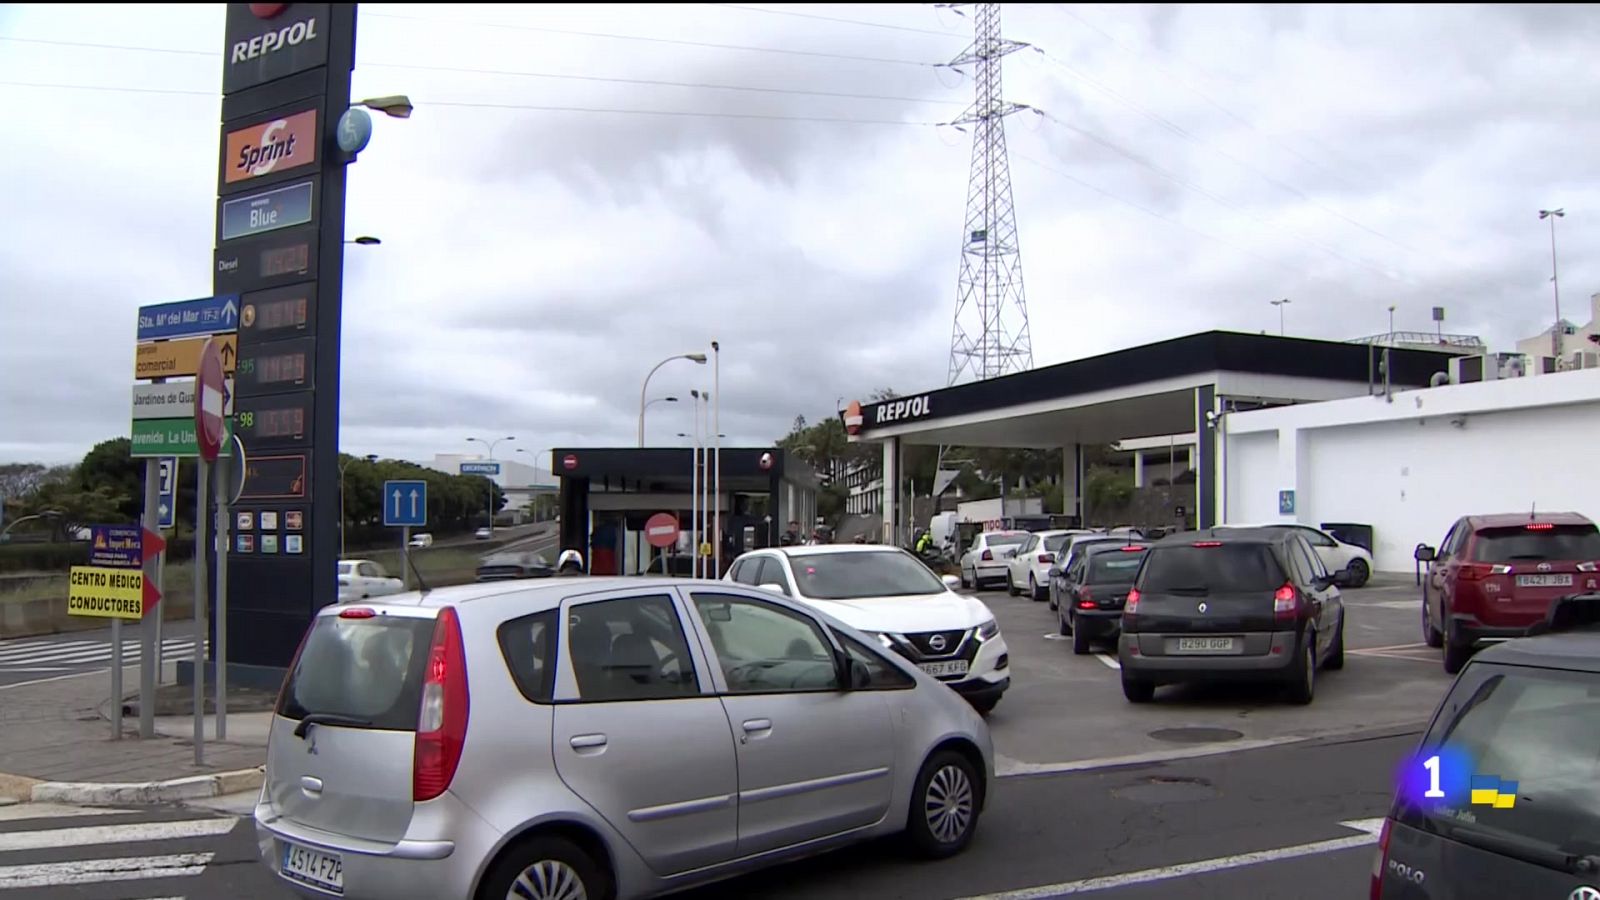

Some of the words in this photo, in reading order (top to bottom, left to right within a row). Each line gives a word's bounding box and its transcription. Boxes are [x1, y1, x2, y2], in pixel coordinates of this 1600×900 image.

[231, 18, 318, 64] REPSOL
[237, 133, 296, 173] Sprint
[250, 208, 278, 228] Blue
[218, 258, 238, 271] Diesel
[168, 311, 181, 325] del
[183, 310, 199, 323] Mar
[137, 357, 176, 372] comercial
[134, 392, 165, 405] Jardines
[168, 393, 177, 404] de
[876, 395, 930, 424] REPSOL
[240, 412, 253, 428] 98
[133, 432, 164, 444] avenida
[71, 571, 106, 586] CENTRO
[109, 571, 141, 589] MÉDICO
[70, 596, 141, 613] CONDUCTORES
[290, 849, 318, 875] 4514
[320, 857, 343, 881] FZP
[1388, 859, 1425, 885] POLO
